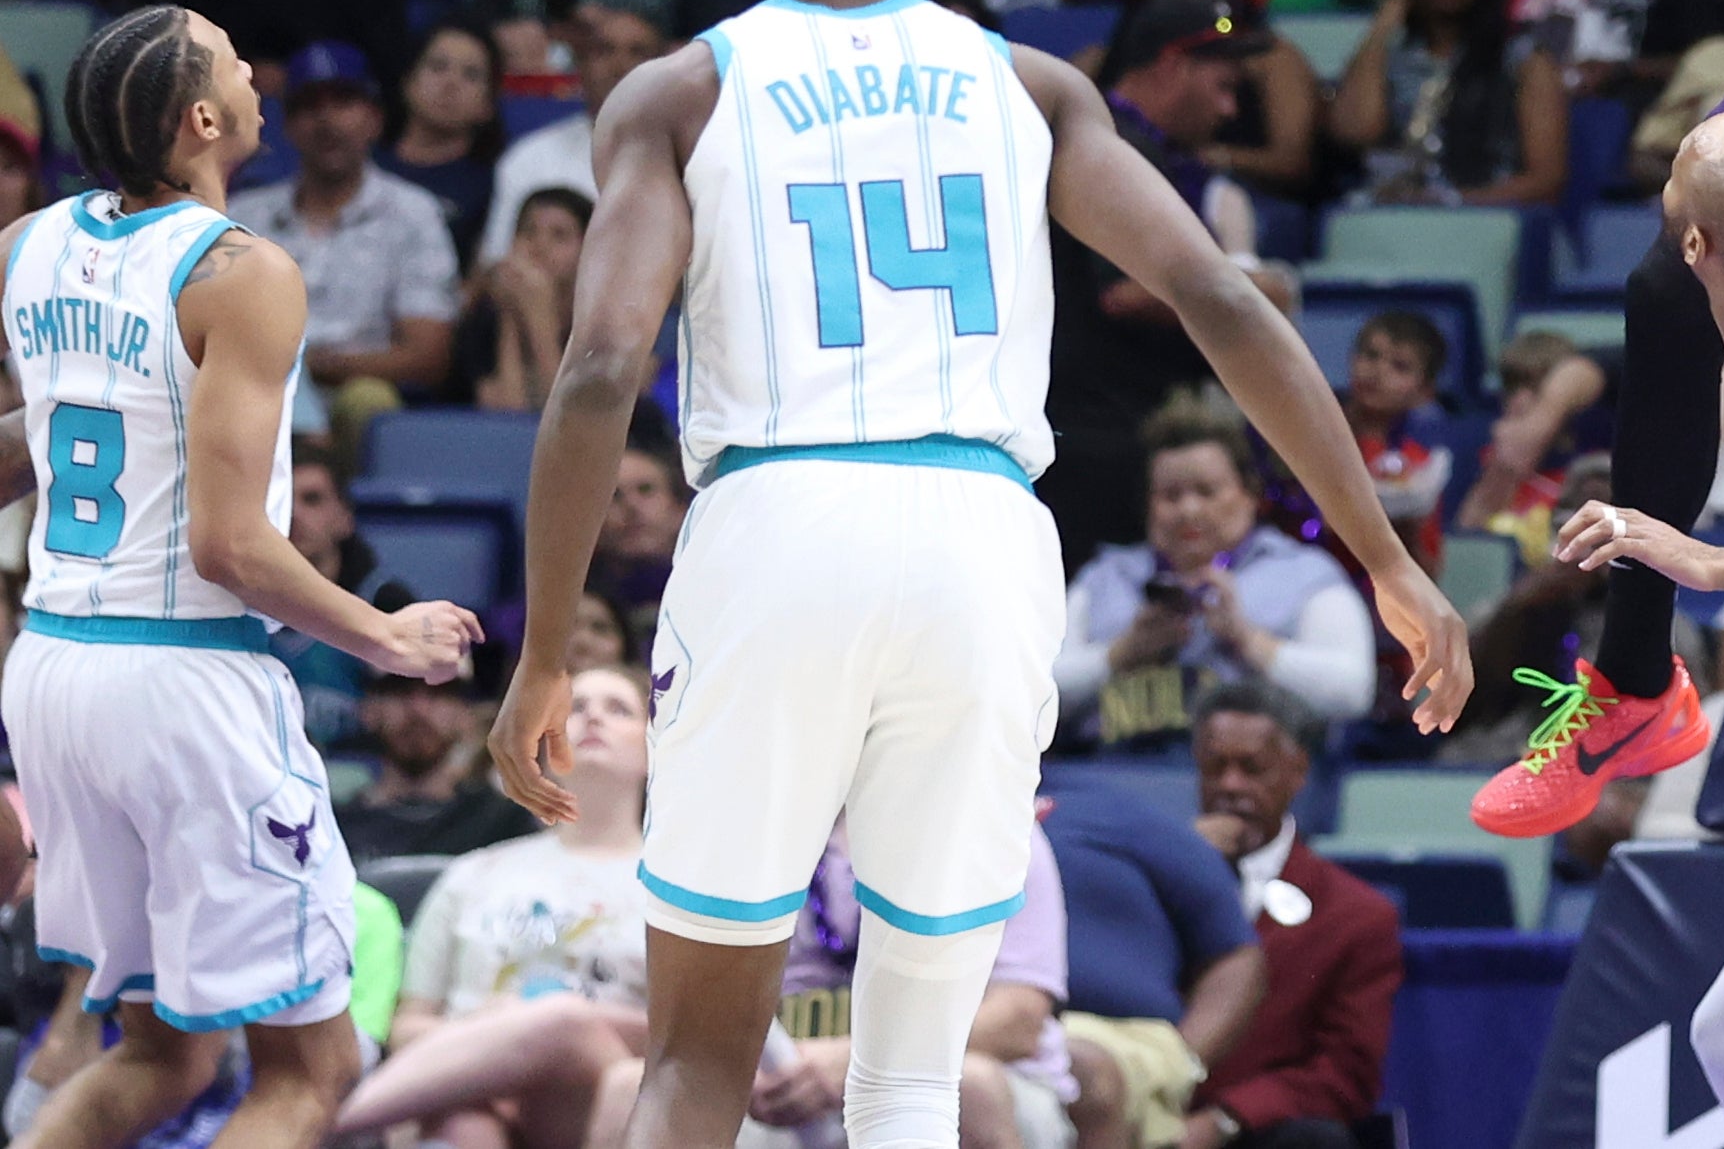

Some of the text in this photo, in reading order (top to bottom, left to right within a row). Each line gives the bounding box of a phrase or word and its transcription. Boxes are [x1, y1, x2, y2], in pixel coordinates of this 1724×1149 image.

[766, 64, 977, 135] DIABATE
[786, 173, 998, 348] 14
[16, 297, 150, 378] SMITH JR.
[45, 402, 127, 559] 8
